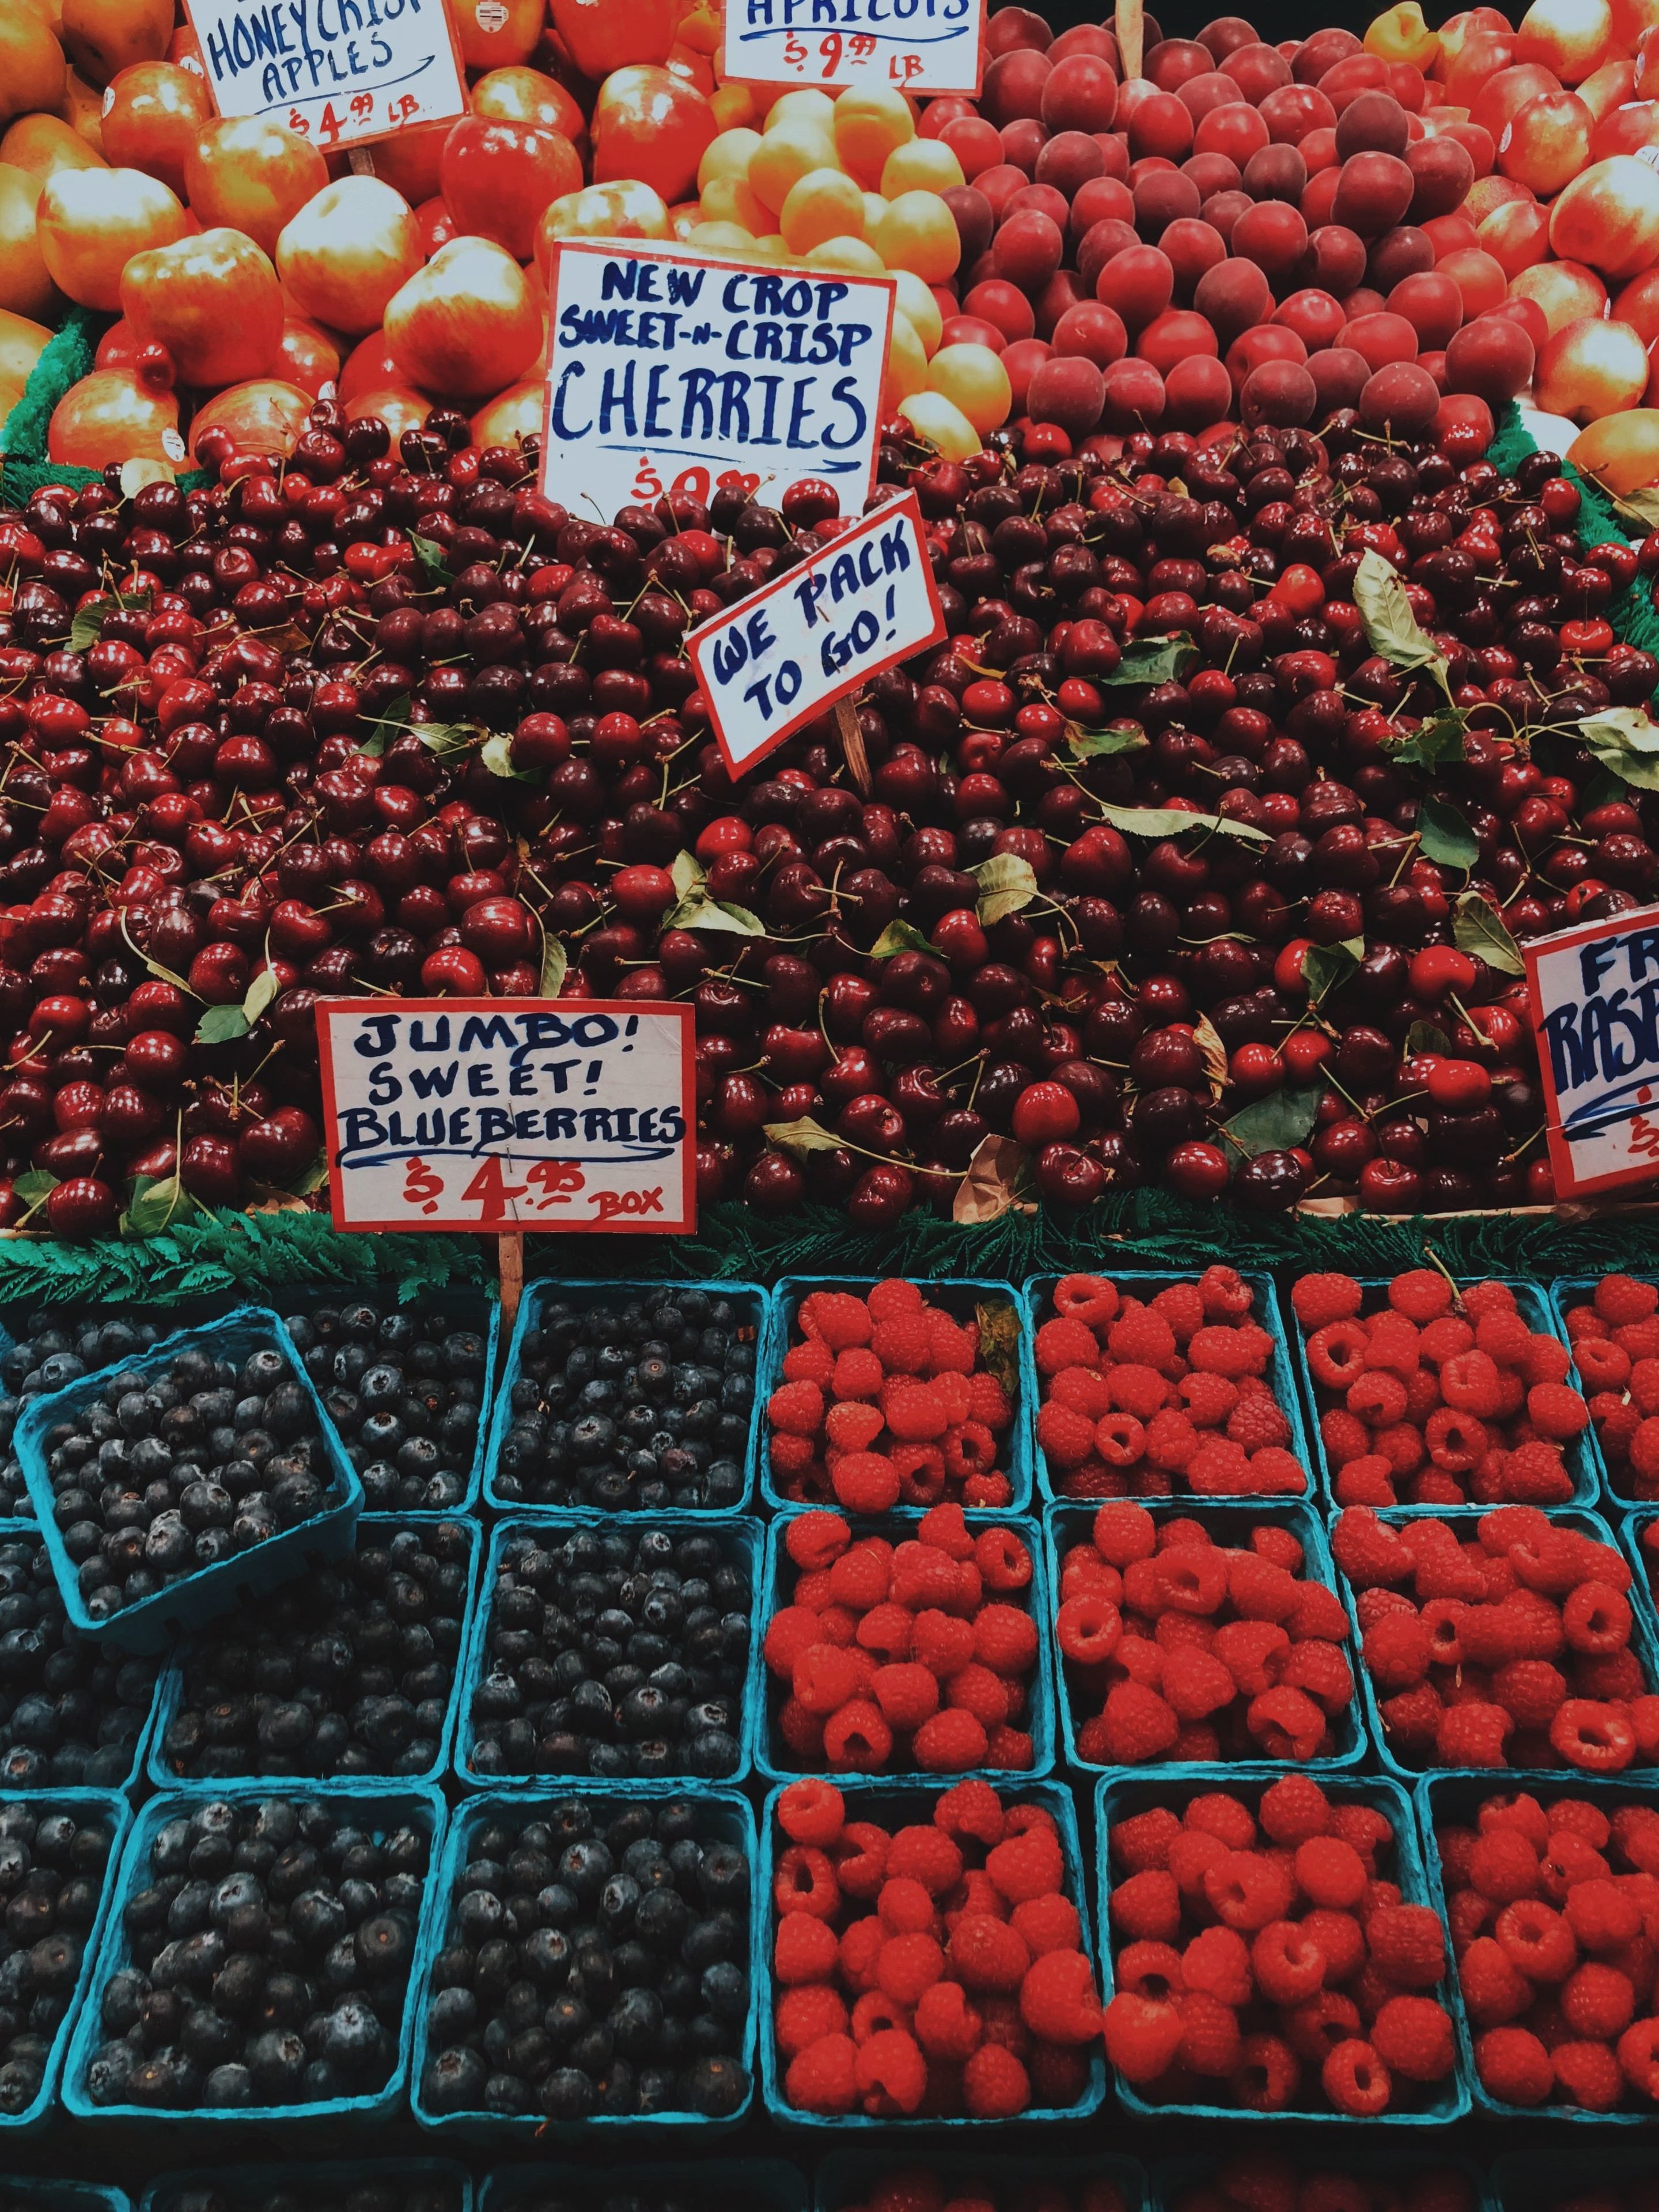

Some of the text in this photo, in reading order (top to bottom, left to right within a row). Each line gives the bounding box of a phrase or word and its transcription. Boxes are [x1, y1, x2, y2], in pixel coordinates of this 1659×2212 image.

[207, 0, 421, 81] HONEYCRI
[262, 32, 392, 103] APPLES
[889, 55, 924, 87] LB
[601, 259, 849, 320] NEW CROP
[552, 360, 867, 450] CHERRIES
[713, 519, 911, 685] WE PACK
[743, 584, 896, 721] TO GO!
[354, 1012, 639, 1066] JUMBO!
[369, 1060, 603, 1106] SWEET!
[335, 1105, 687, 1162] BLUEBERRIES
[588, 1187, 664, 1221] BOX
